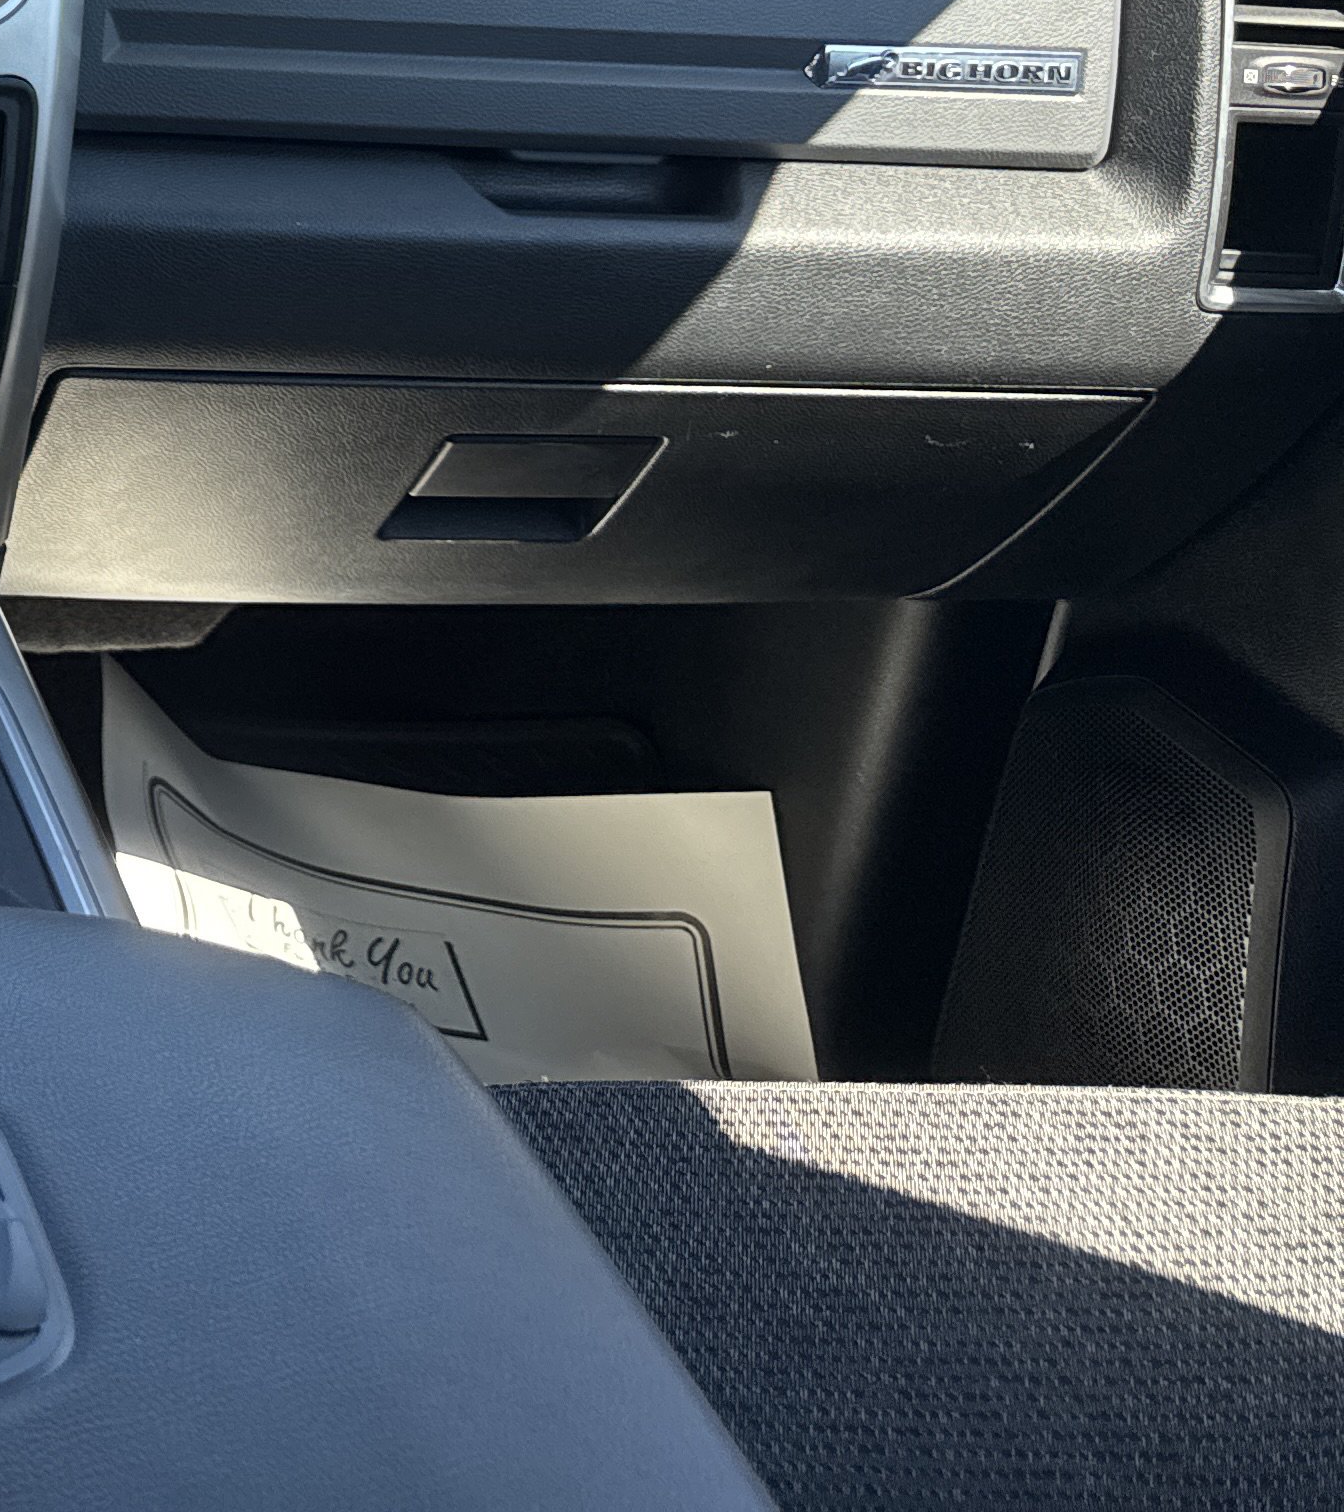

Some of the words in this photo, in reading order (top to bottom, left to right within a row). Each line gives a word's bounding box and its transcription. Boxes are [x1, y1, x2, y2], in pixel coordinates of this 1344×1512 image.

[900, 58, 962, 82] BIG
[966, 59, 1072, 86] HORN
[367, 936, 439, 992] You
